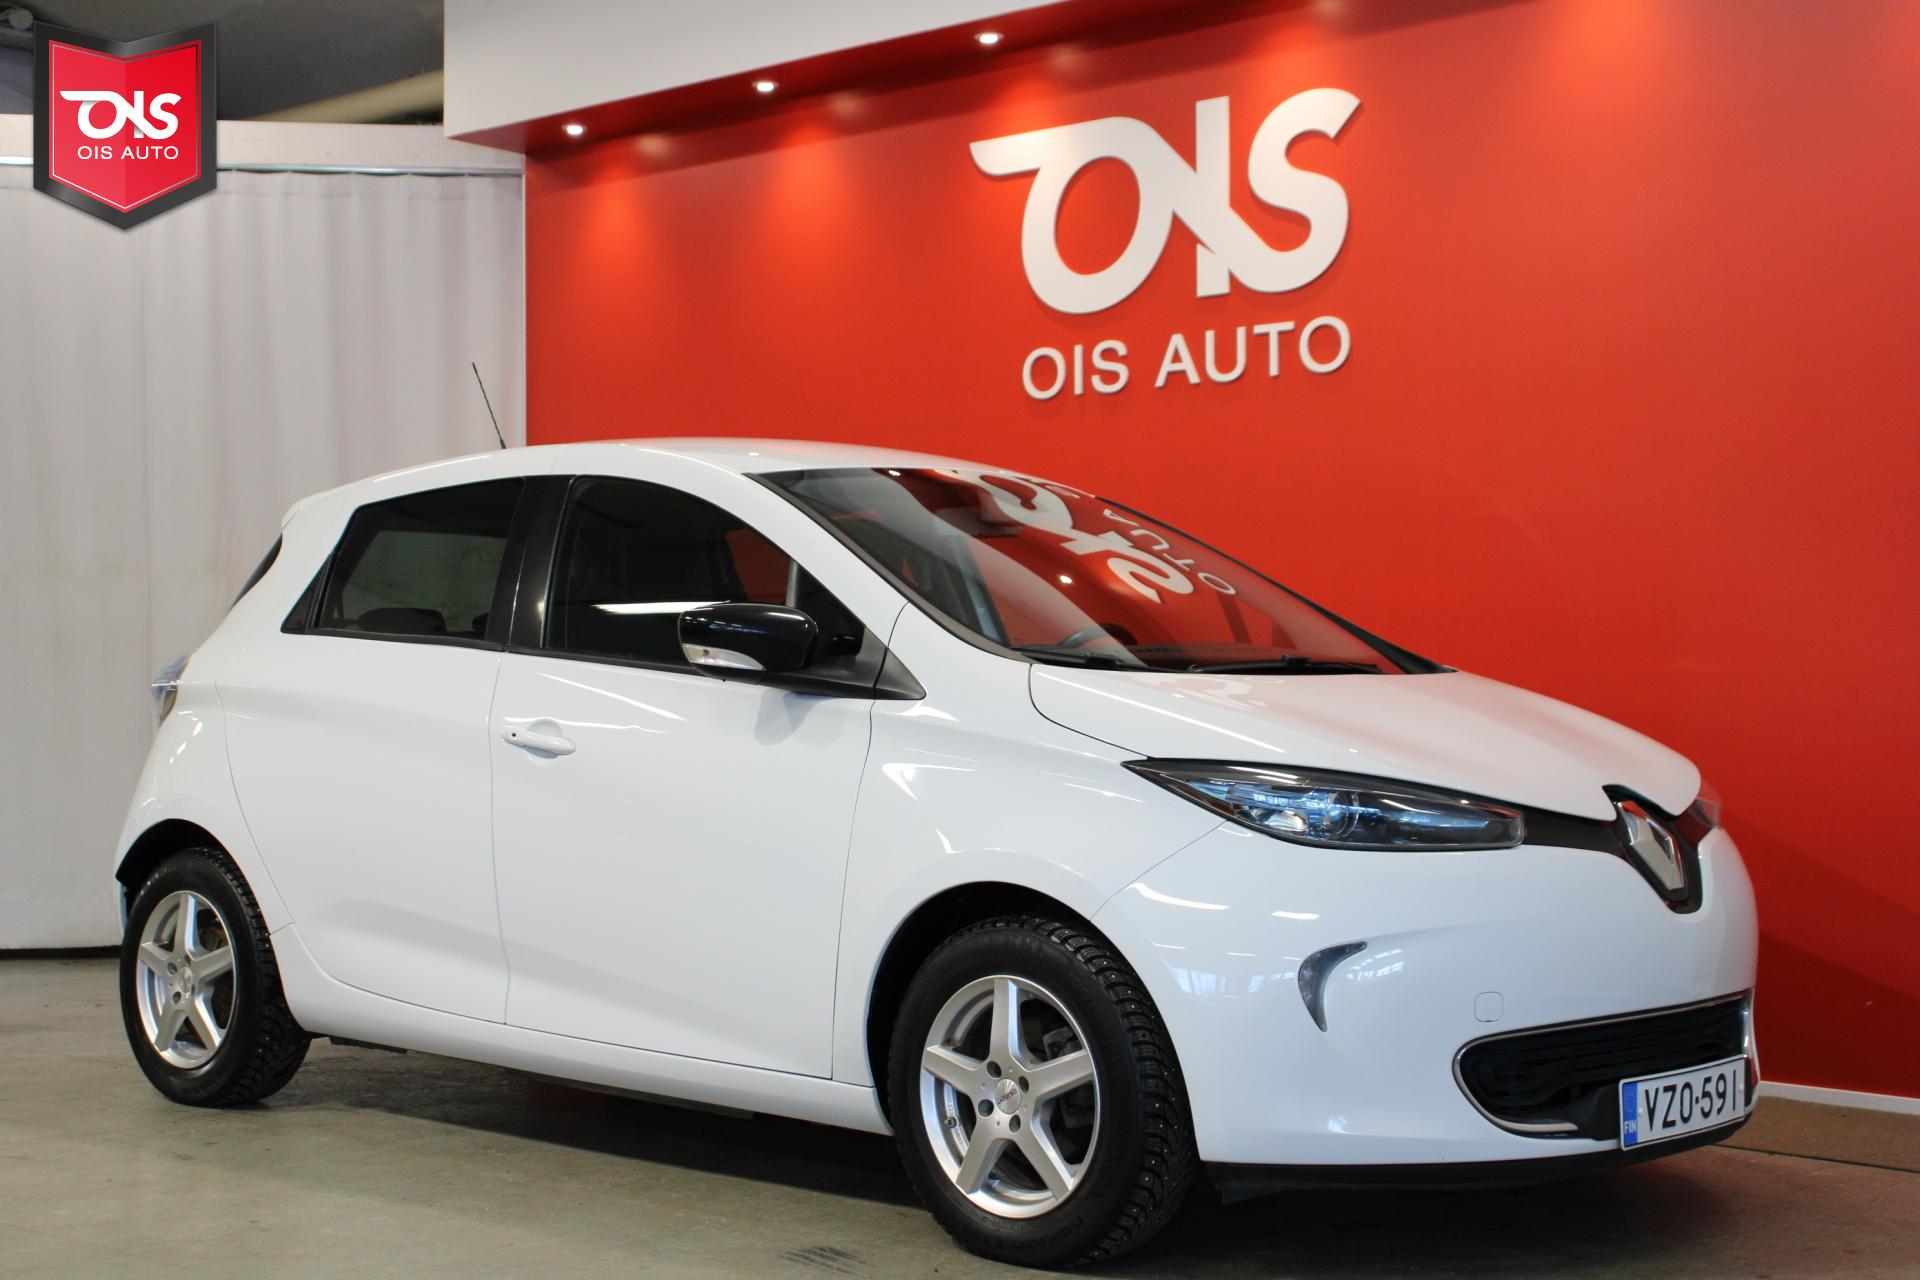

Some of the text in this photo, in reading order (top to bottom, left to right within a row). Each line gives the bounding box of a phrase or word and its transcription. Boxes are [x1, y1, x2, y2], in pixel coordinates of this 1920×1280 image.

[1022, 316, 1351, 400] OIS AUTO
[1624, 1120, 1637, 1134] FIN
[1645, 1070, 1736, 1131] VZO-591
